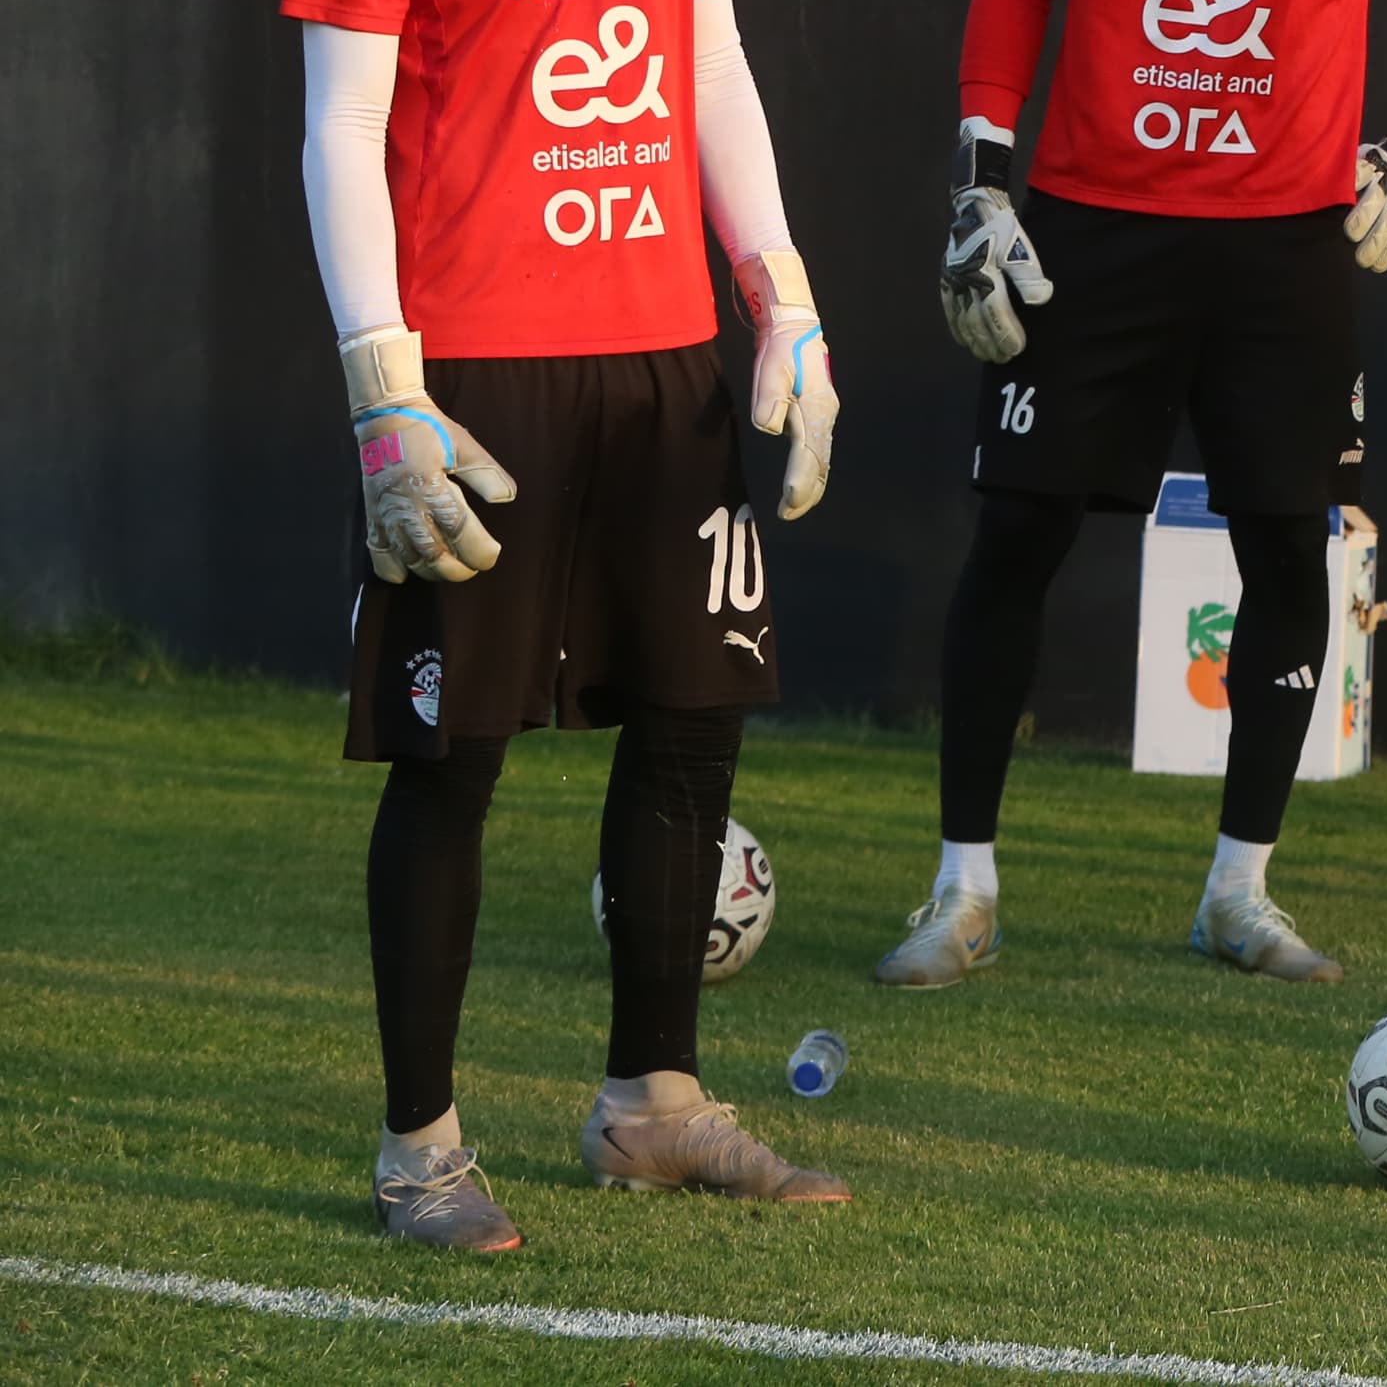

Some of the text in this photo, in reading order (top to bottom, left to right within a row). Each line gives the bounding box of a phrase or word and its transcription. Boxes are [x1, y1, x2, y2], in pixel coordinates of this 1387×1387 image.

[531, 5, 671, 128] e&
[1133, 65, 1273, 95] etisalat and
[532, 134, 671, 172] etisalat and
[1000, 382, 1036, 434] 16
[698, 503, 764, 614] 10
